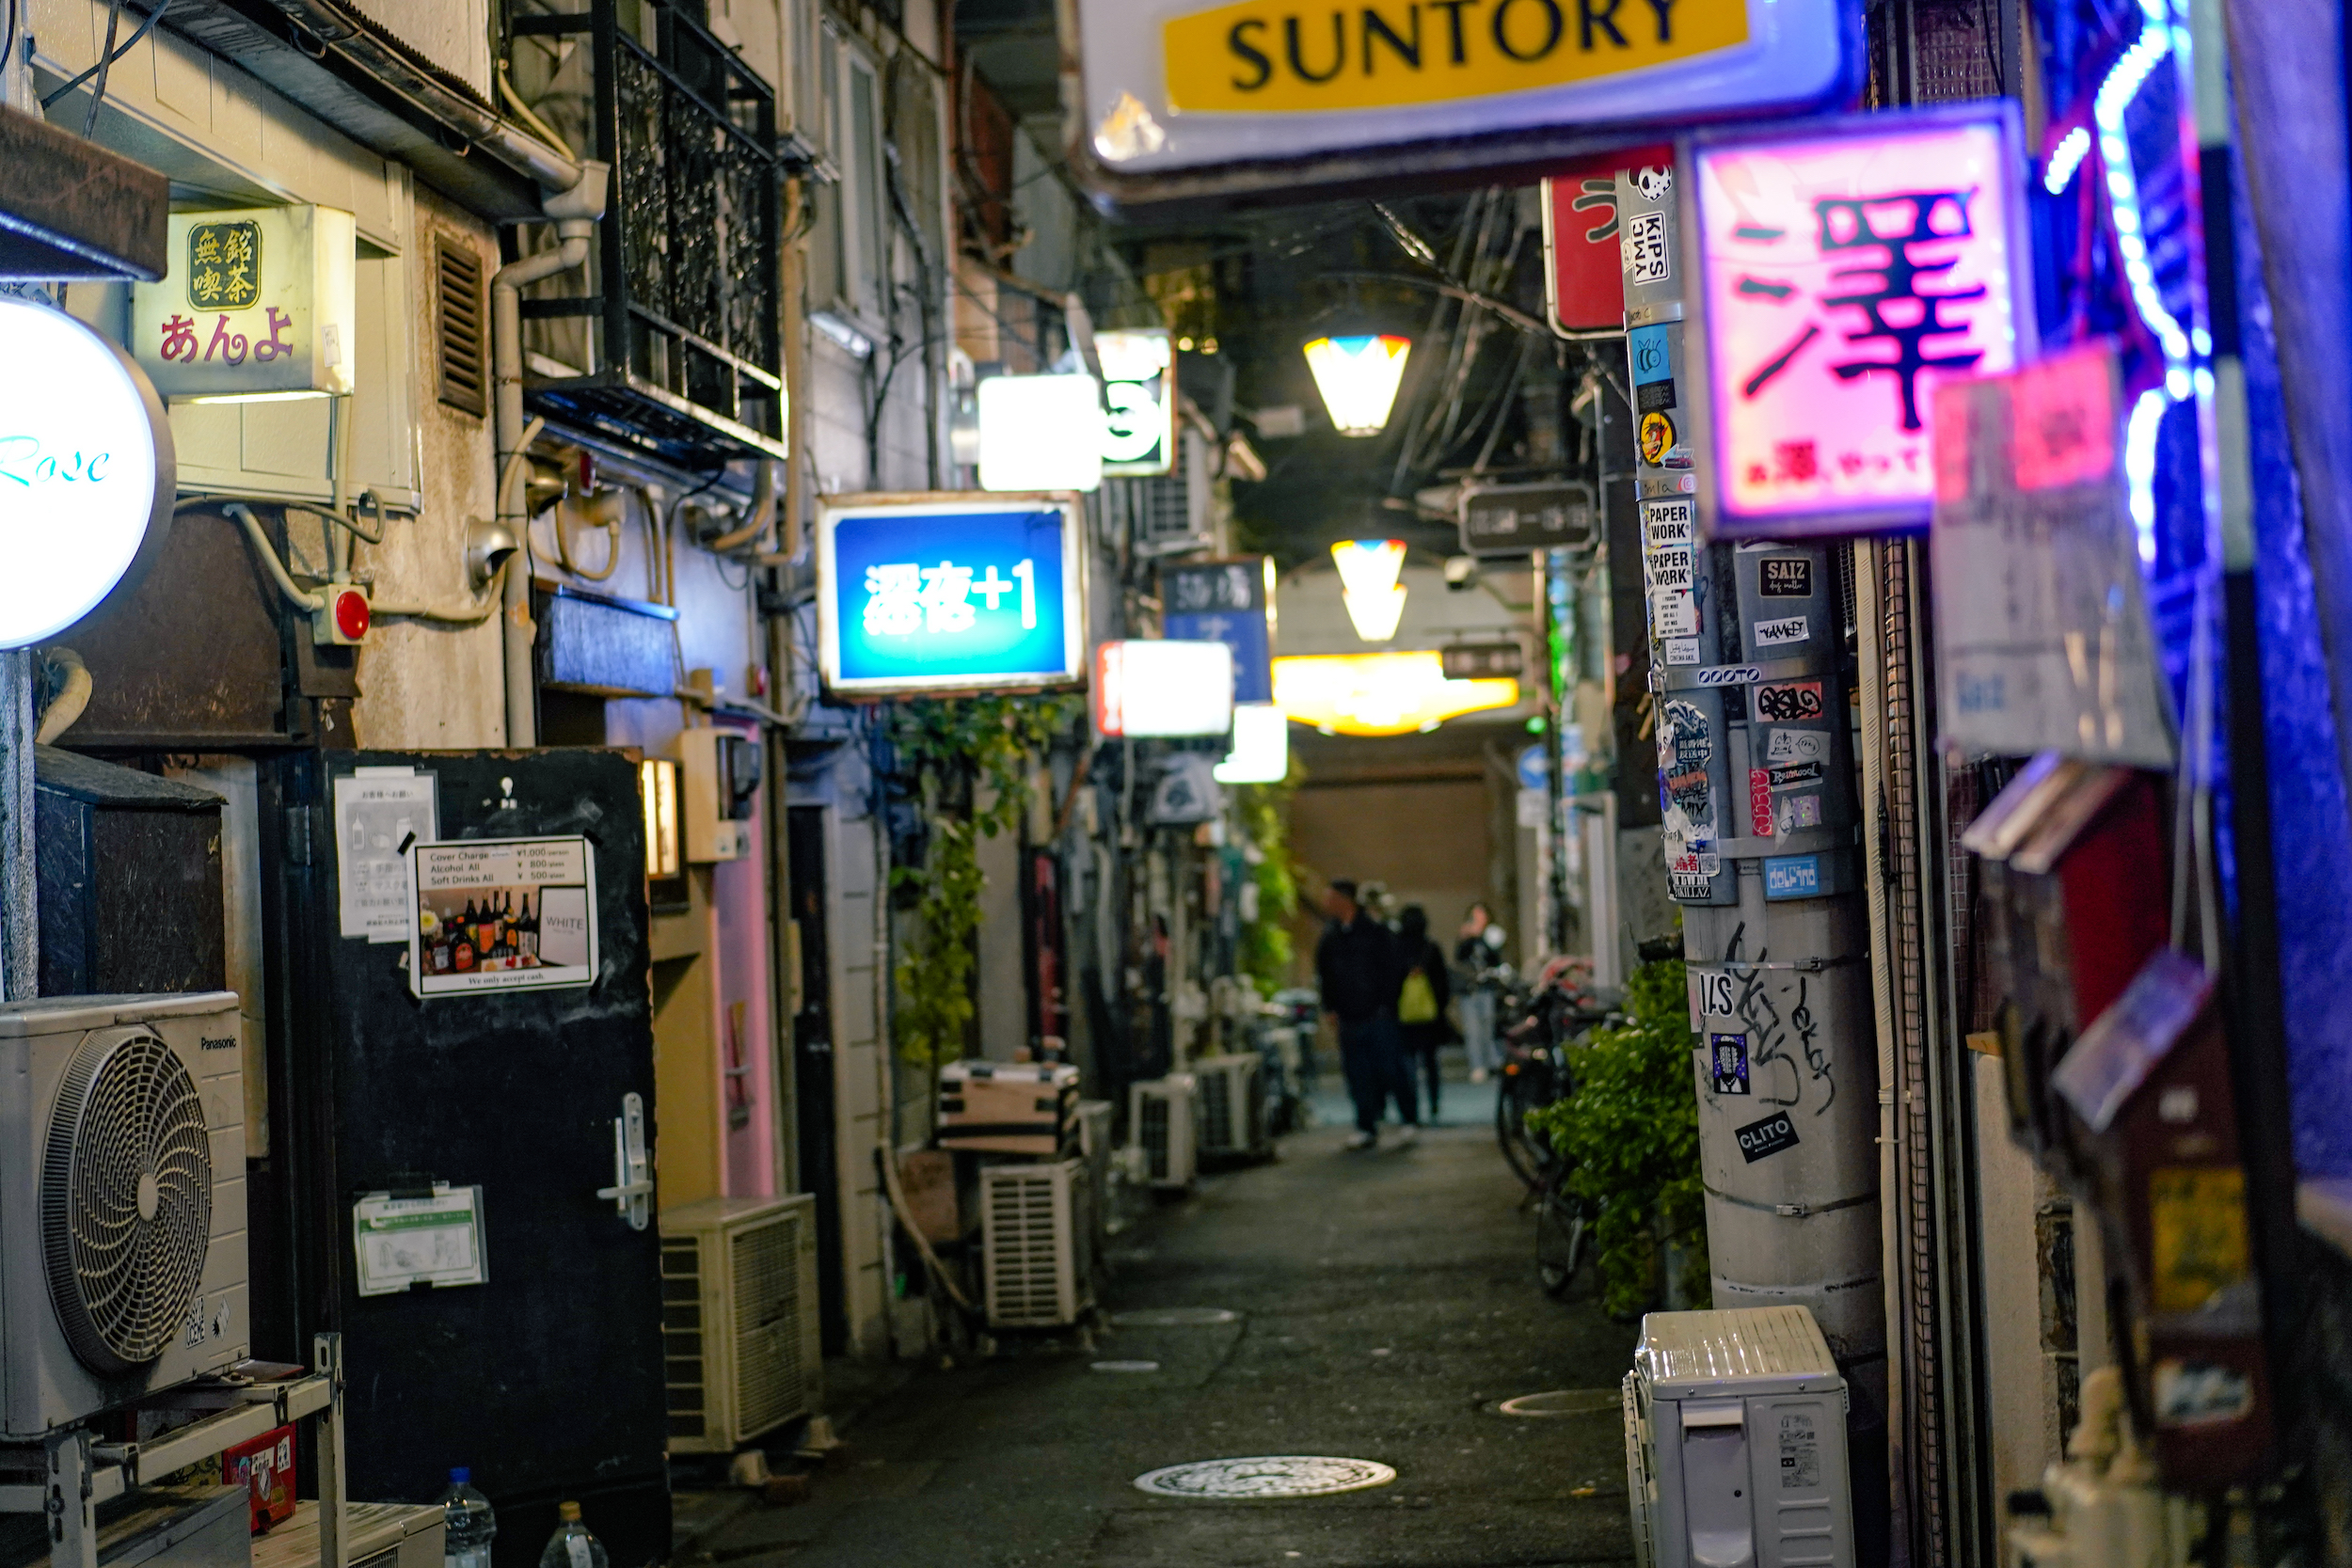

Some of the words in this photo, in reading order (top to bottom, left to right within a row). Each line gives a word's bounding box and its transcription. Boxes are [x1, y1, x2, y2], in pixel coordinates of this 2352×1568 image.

[1227, 0, 1671, 91] SUNTORY
[1733, 186, 1987, 433] 澤
[160, 307, 294, 367] あんよ
[1650, 505, 1688, 523] PAPER
[1651, 524, 1687, 540] WORK
[1653, 551, 1689, 569] PAPER
[1768, 562, 1805, 579] SAIZ
[430, 852, 455, 862] Cover
[458, 851, 489, 861] Charge
[431, 863, 464, 874] Alcohol
[469, 863, 481, 871] All
[530, 860, 548, 869] 800
[431, 876, 450, 886] Soft
[452, 875, 481, 884] Drinks
[482, 874, 494, 883] All
[531, 872, 548, 880] 500
[546, 915, 585, 930] WHITE
[484, 975, 501, 987] only
[502, 974, 525, 985] accept
[527, 972, 546, 981] cash.
[201, 1036, 237, 1051] Panasonic
[1740, 1119, 1789, 1149] CLITO
